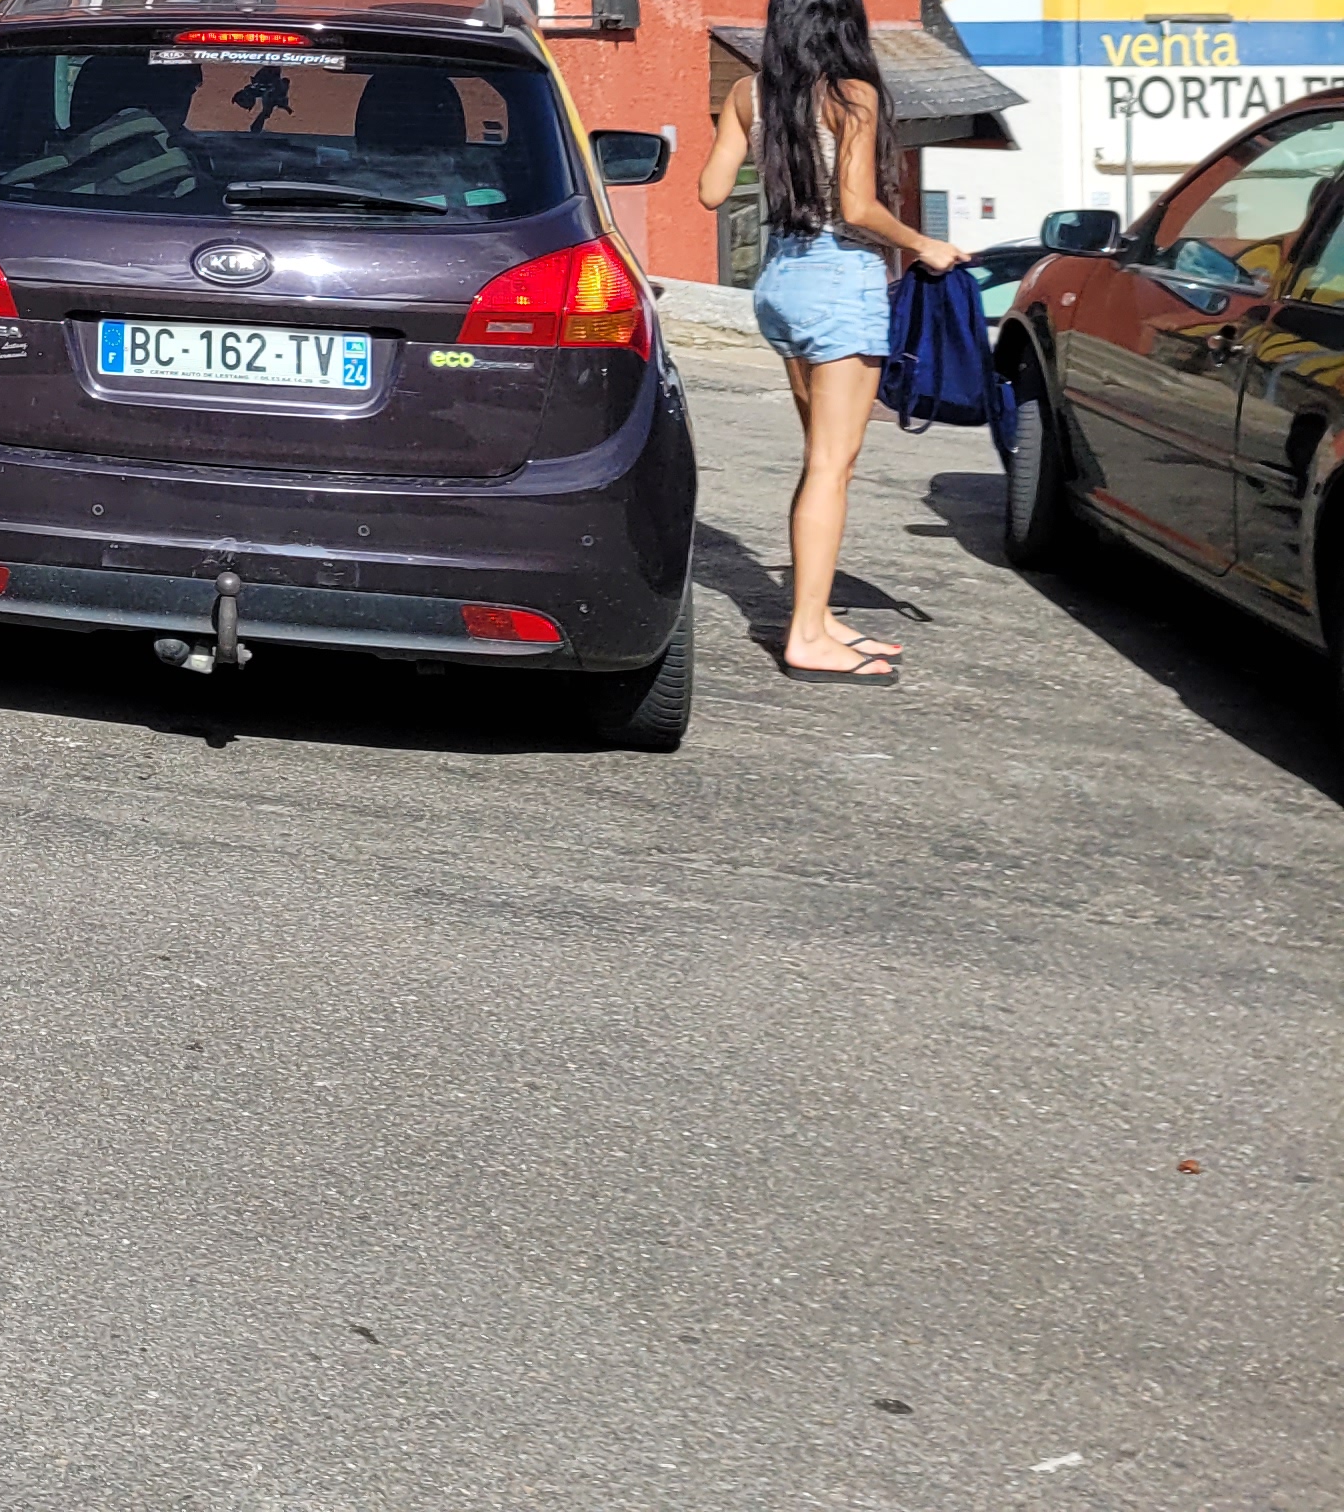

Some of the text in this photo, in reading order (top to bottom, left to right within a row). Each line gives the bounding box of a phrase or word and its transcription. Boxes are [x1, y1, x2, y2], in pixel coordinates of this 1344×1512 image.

[1101, 27, 1240, 68] venta
[193, 50, 218, 59] The
[219, 52, 265, 62] Power
[282, 54, 340, 66] Surprise
[209, 254, 255, 272] KIA
[108, 352, 116, 364] F
[130, 326, 335, 377] BC-162-TV
[150, 369, 179, 377] CENTRE
[344, 363, 365, 383] 24
